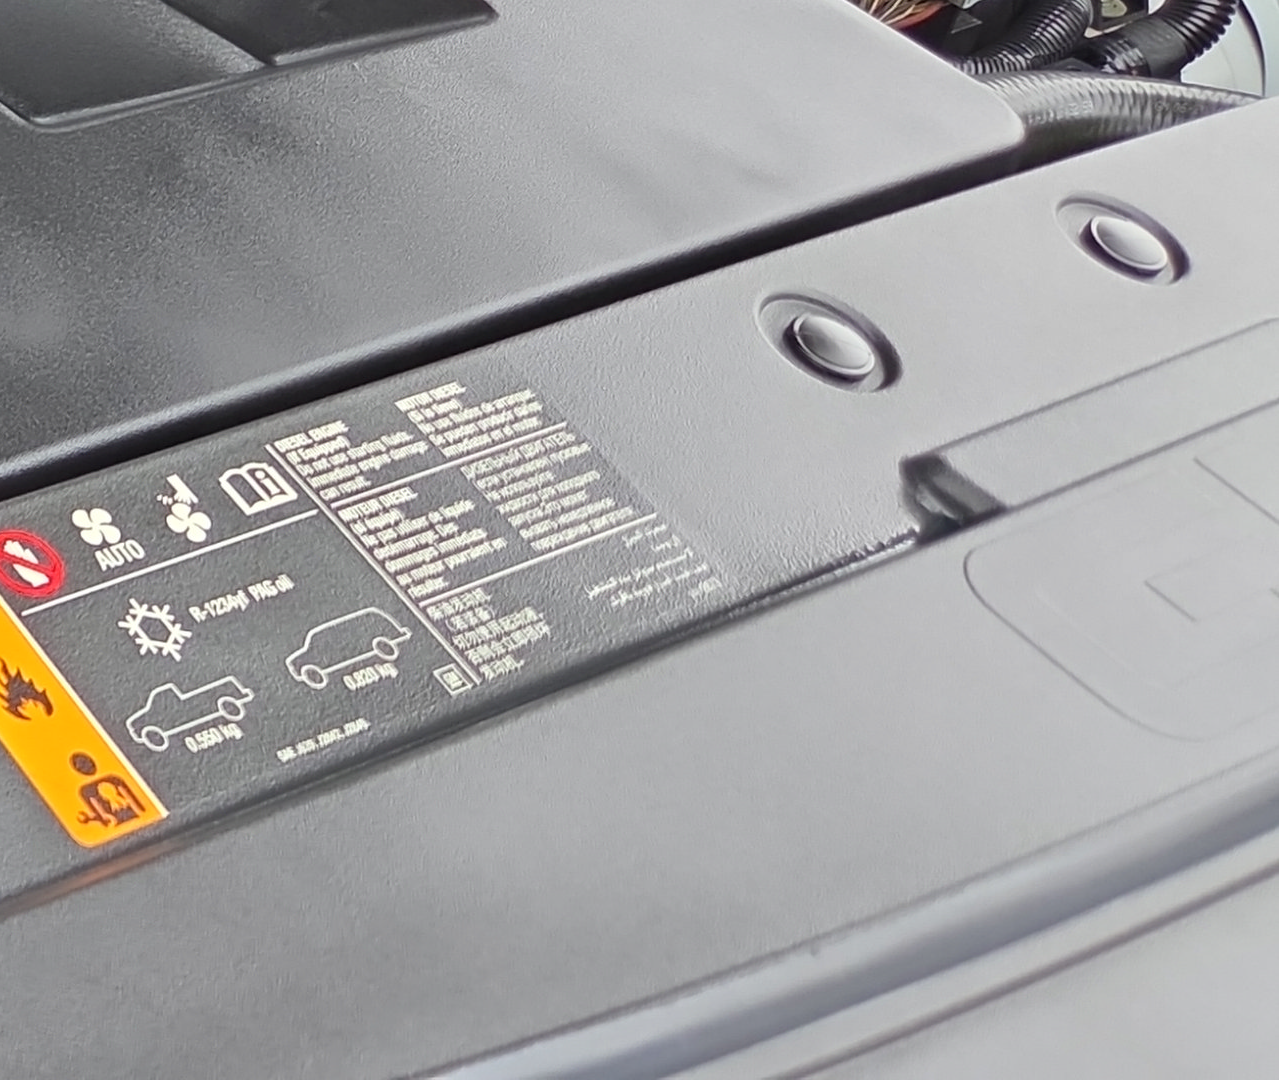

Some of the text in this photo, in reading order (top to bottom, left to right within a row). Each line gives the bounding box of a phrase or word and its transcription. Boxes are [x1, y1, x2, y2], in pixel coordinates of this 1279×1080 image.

[272, 419, 350, 453] DIESEL ENGINE
[335, 485, 421, 523] MOTEUR DIESEL
[94, 539, 145, 571] AUTO
[188, 590, 249, 623] R-1234yf
[248, 580, 279, 603] PAG
[379, 662, 399, 681] kg
[218, 722, 245, 742] kg
